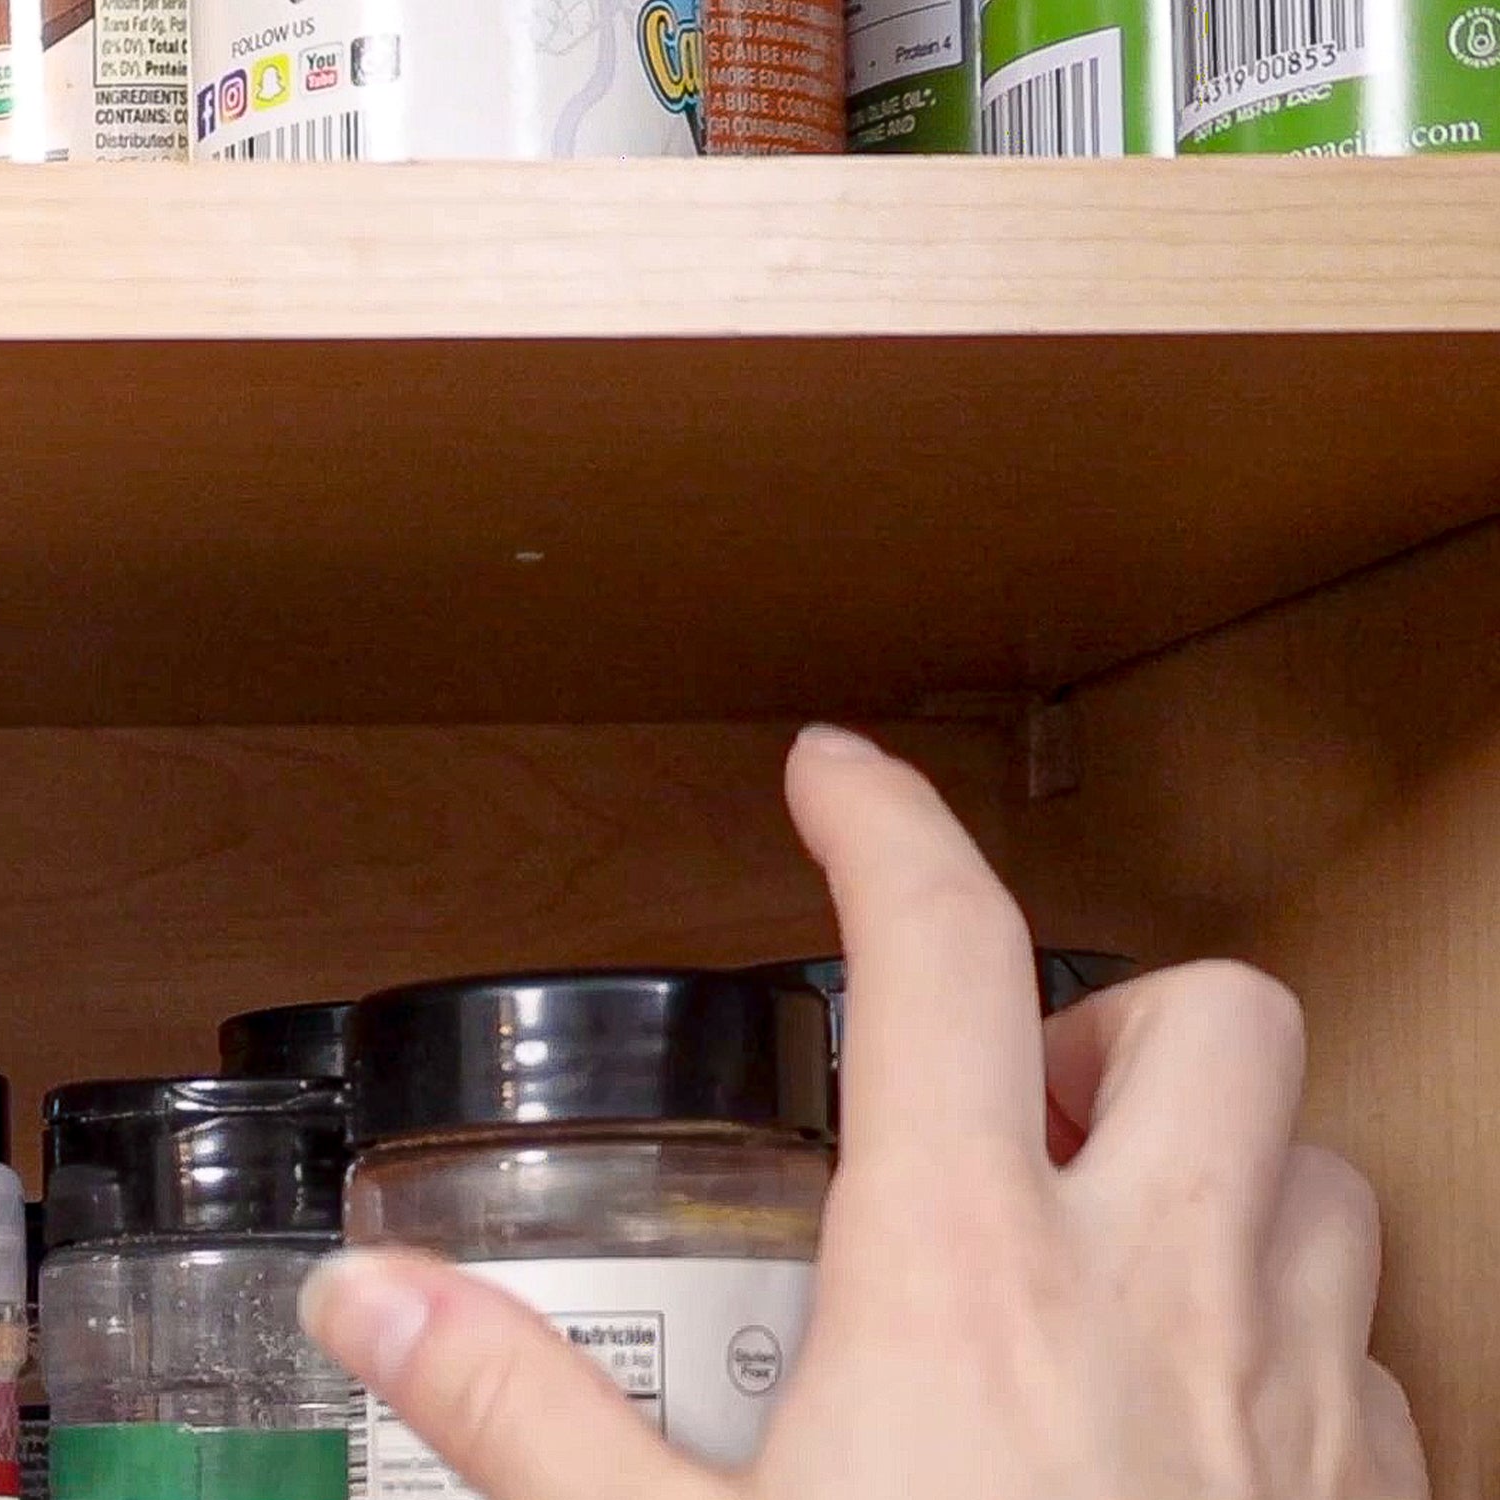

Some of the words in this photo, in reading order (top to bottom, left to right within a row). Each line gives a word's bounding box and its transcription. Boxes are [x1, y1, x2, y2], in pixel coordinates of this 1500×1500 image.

[148, 38, 179, 54] Total
[231, 22, 289, 58] FOLLOW
[292, 17, 316, 38] US
[306, 53, 337, 70] You
[1257, 44, 1336, 84] 00853
[95, 90, 187, 105] INGREDIENTS
[95, 108, 171, 125] CONTAINS:
[96, 133, 175, 149] Distributed
